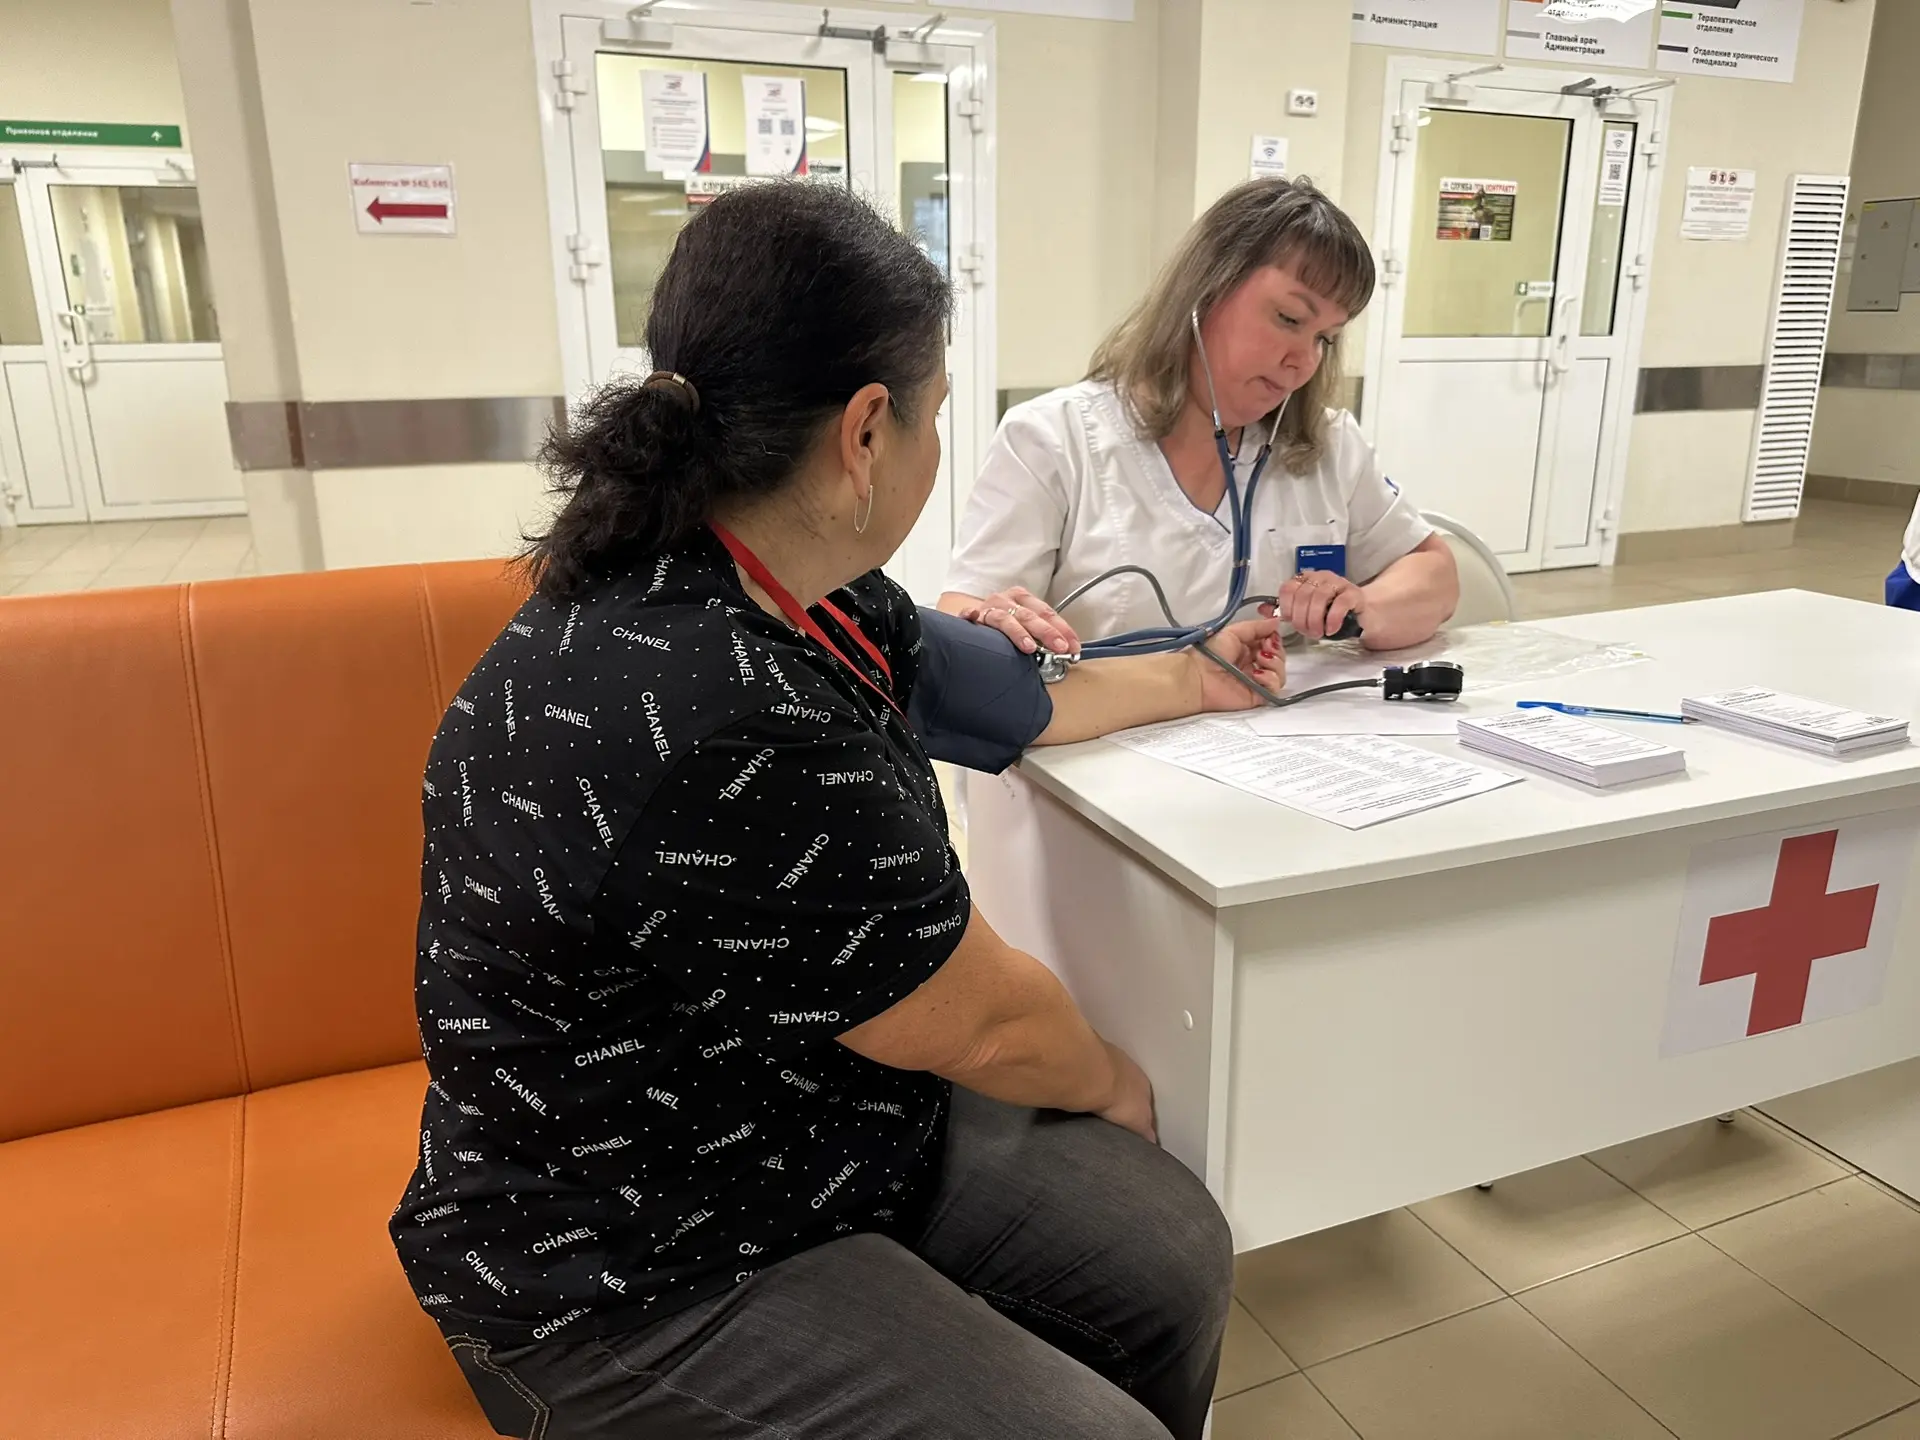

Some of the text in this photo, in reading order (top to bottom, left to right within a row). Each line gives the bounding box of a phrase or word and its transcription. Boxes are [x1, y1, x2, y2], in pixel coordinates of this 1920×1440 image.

[1370, 13, 1438, 28] Администрация
[1696, 24, 1733, 34] отделение
[1698, 13, 1757, 27] Терапевтическое
[1544, 42, 1605, 55] Администрация
[1545, 32, 1578, 43] Главный
[1692, 57, 1737, 68] гемодиализа
[1693, 47, 1778, 63] Отделение хронического
[508, 622, 534, 638] CHANEL
[559, 604, 580, 656] CHANEL
[612, 626, 672, 651] CHANEL
[504, 679, 517, 742] CHANEL
[544, 703, 592, 729] CHANEL
[770, 703, 831, 723] CHANE
[880, 705, 890, 730] NEL
[641, 691, 671, 761] CHANEL
[719, 748, 775, 800] CHANEL
[816, 770, 874, 785] CHANEL
[459, 761, 471, 827] CHANEL
[501, 791, 544, 818] CHANEL
[579, 778, 615, 848] CHANEL
[655, 851, 734, 866] CHANEL
[776, 833, 829, 890] CHANEL
[870, 851, 920, 870] CHANEL
[439, 871, 452, 904] NEL
[464, 875, 501, 904] CHANEL
[629, 910, 667, 950] CHAN
[916, 915, 961, 939] CHANEL
[713, 938, 790, 949] CHANEL
[832, 914, 883, 965] CHANEL
[437, 1018, 490, 1030] CHANEL
[769, 1011, 840, 1024] CHANEL
[575, 1038, 645, 1068] CHANEL
[703, 1037, 744, 1059] CHAN
[494, 1067, 547, 1117] CHANEL
[646, 1087, 679, 1110] ANEL
[571, 1135, 632, 1158] CHANEL
[697, 1121, 756, 1155] CHANEL
[421, 1129, 437, 1186] CHANEL
[617, 1184, 644, 1207] NEL
[810, 1160, 860, 1209] CHANEL
[414, 1201, 460, 1223] CHANEL
[532, 1226, 597, 1254] CHANEL
[465, 1250, 509, 1296] CHANEL
[601, 1271, 628, 1294] NEL
